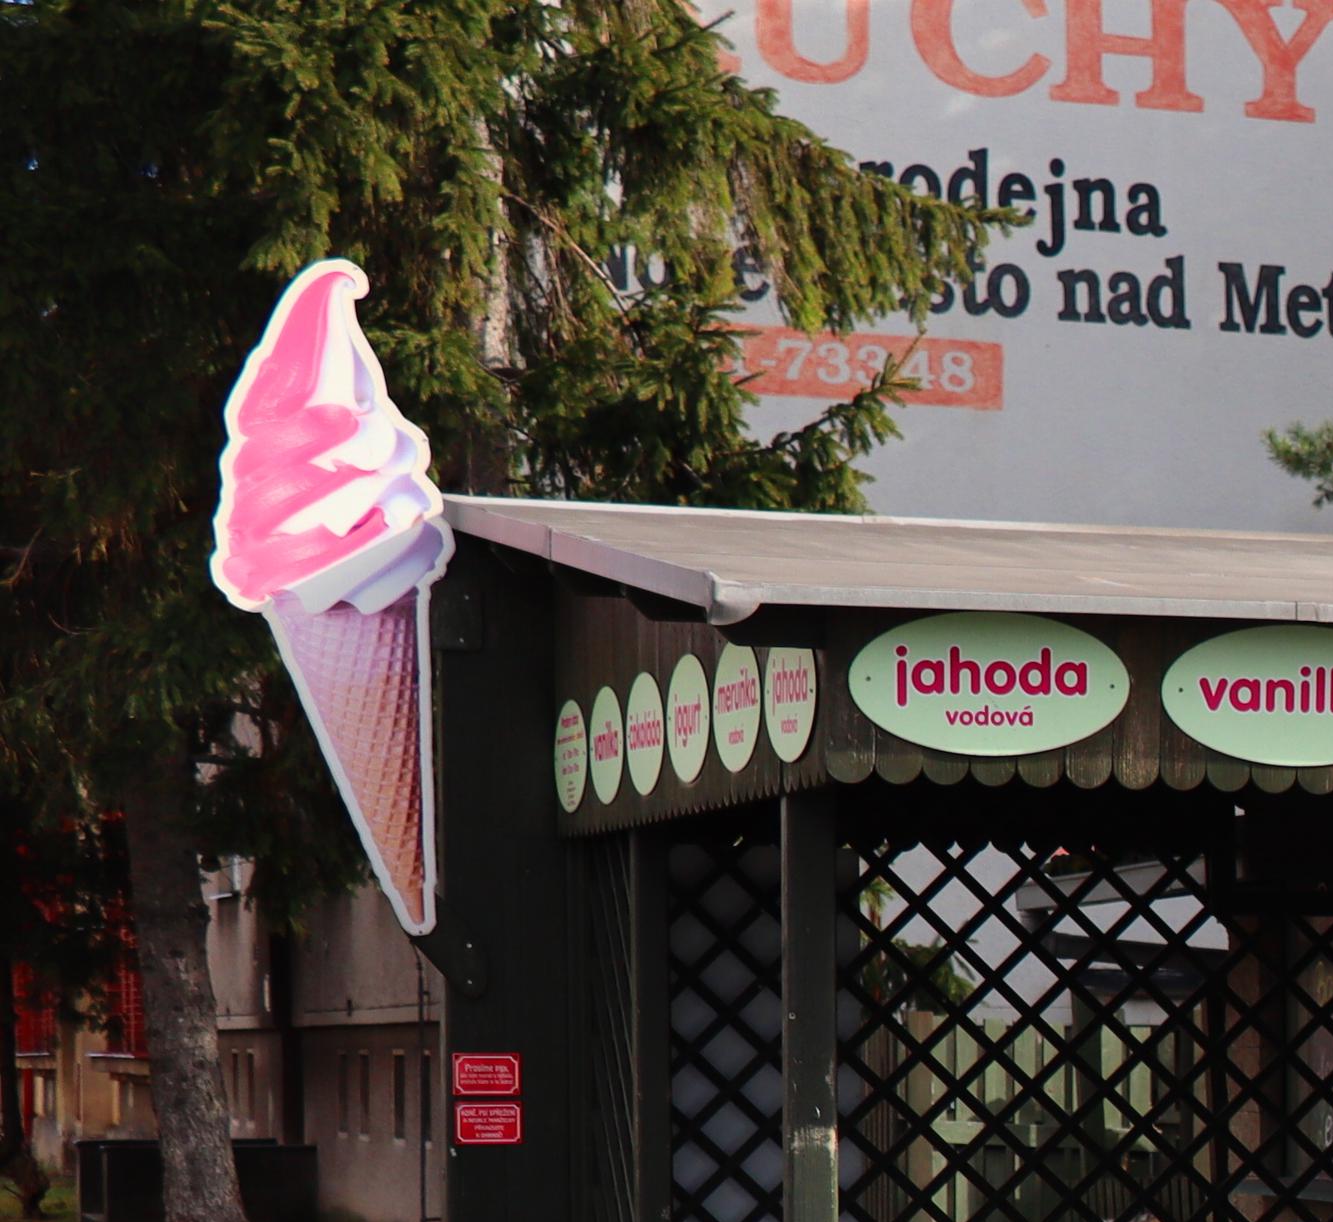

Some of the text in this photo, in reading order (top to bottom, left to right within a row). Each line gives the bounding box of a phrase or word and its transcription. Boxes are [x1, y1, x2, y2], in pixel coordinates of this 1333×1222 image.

[859, 147, 1168, 257] odejna
[1057, 255, 1191, 331] nad
[895, 646, 1088, 706] jahoda
[945, 705, 1034, 727] vodová
